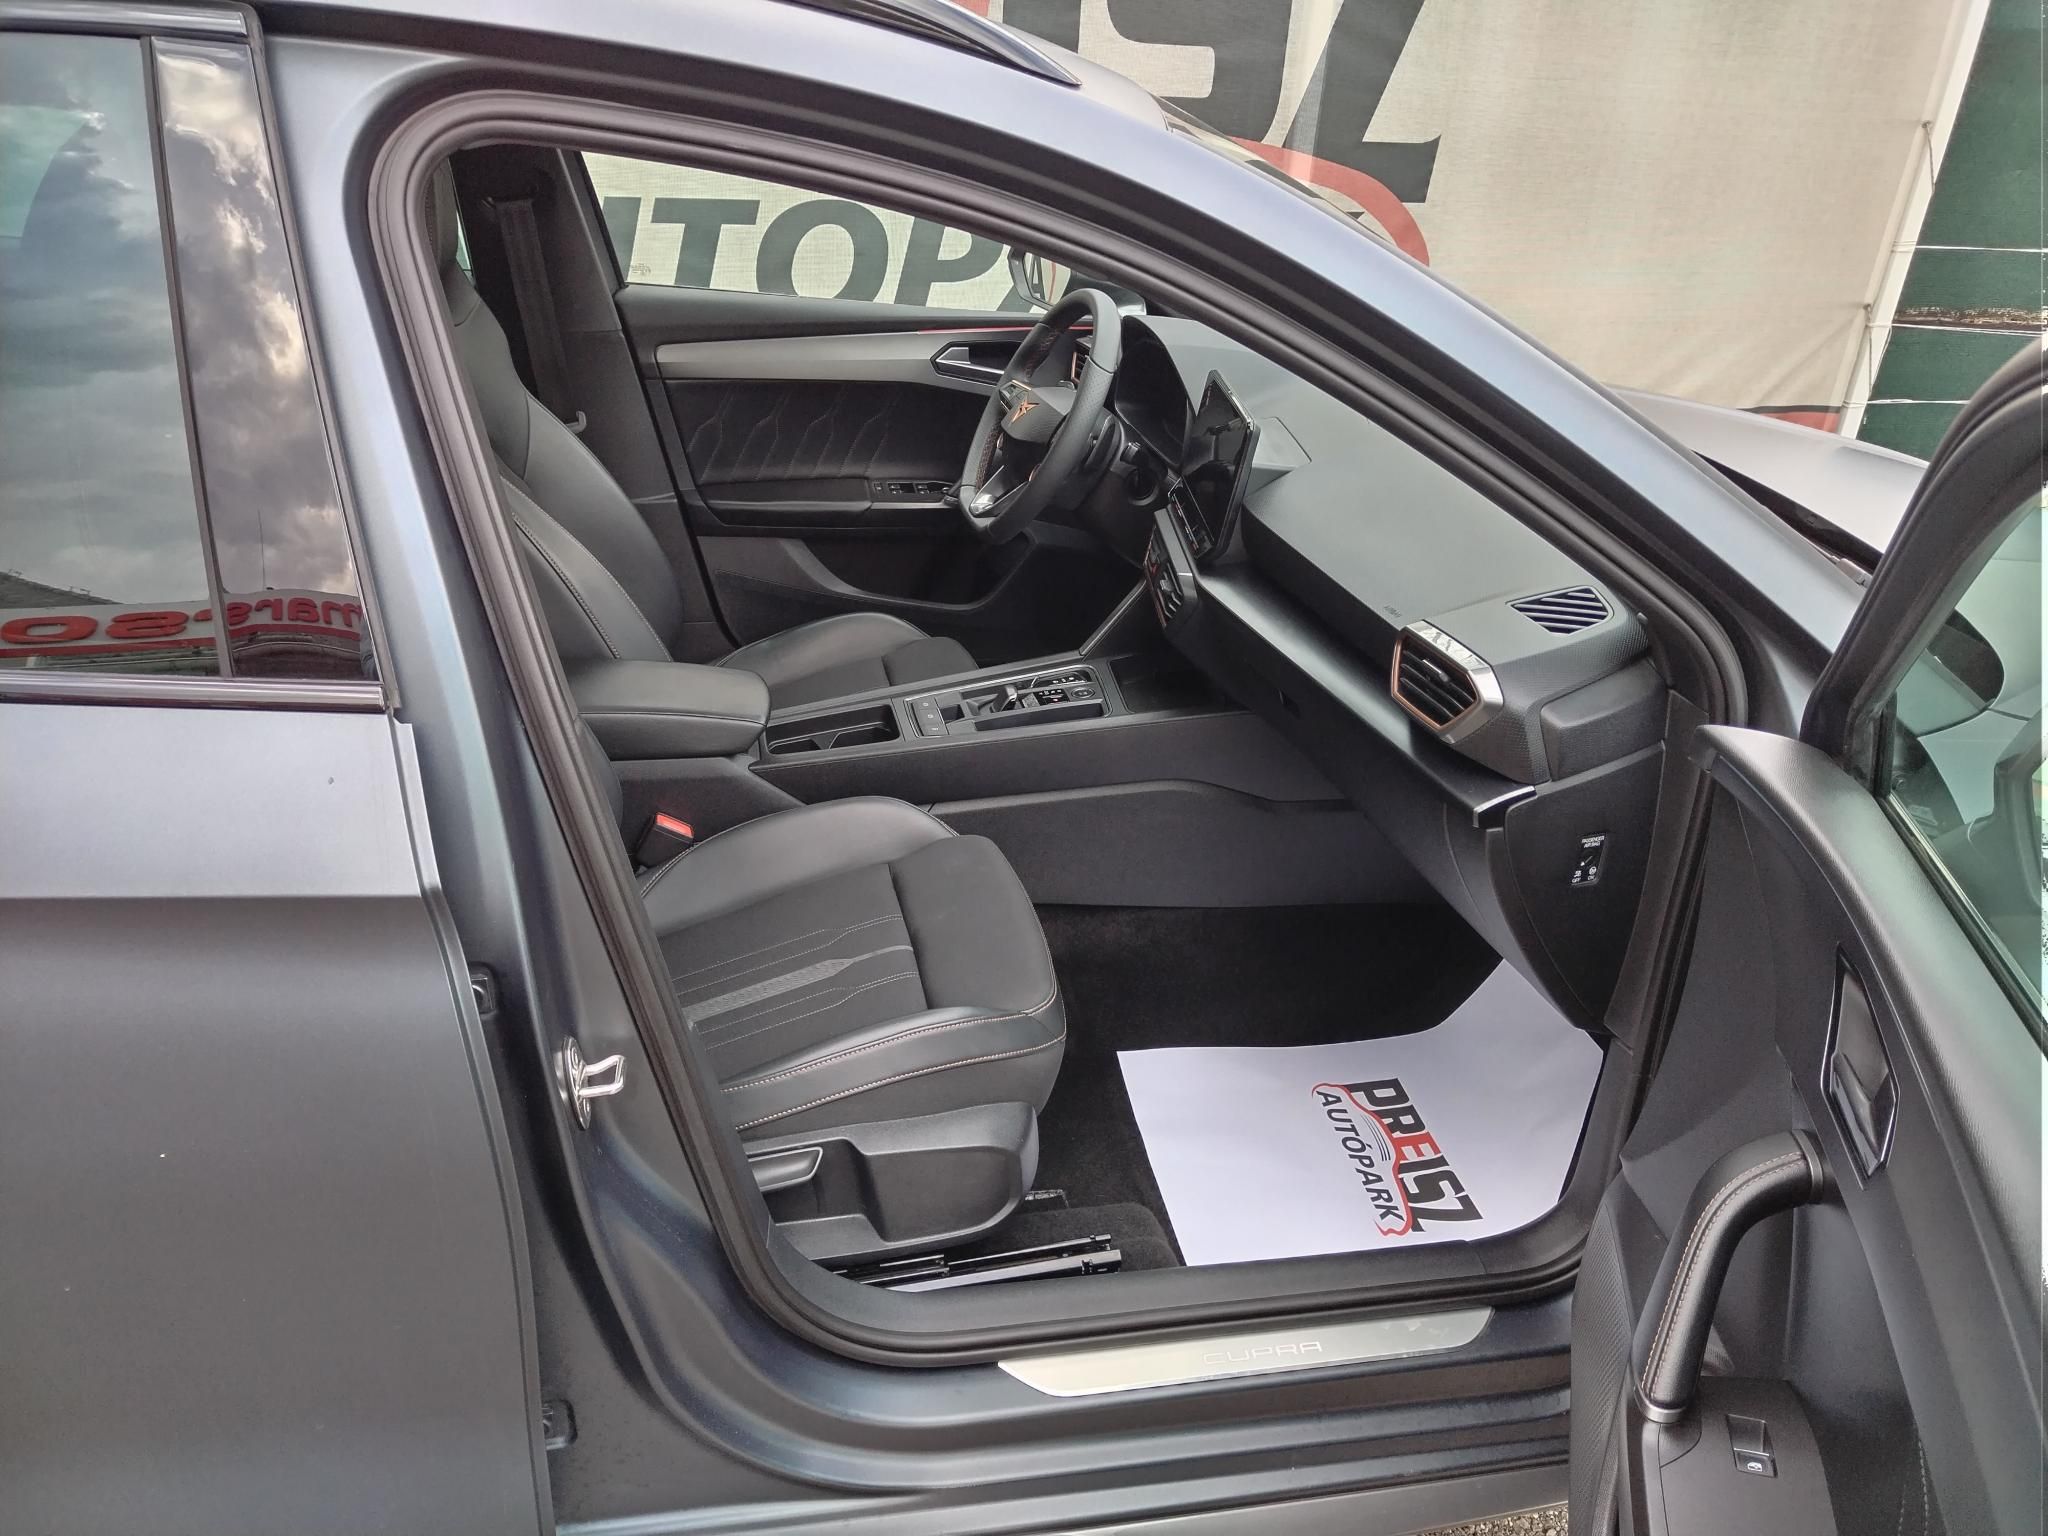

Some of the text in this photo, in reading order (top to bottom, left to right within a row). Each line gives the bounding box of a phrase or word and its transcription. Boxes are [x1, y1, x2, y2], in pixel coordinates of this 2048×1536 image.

[1316, 1090, 1405, 1222] AUTÓPARK
[1342, 1078, 1484, 1232] PREISZ
[1203, 1341, 1323, 1365] CUPRA
